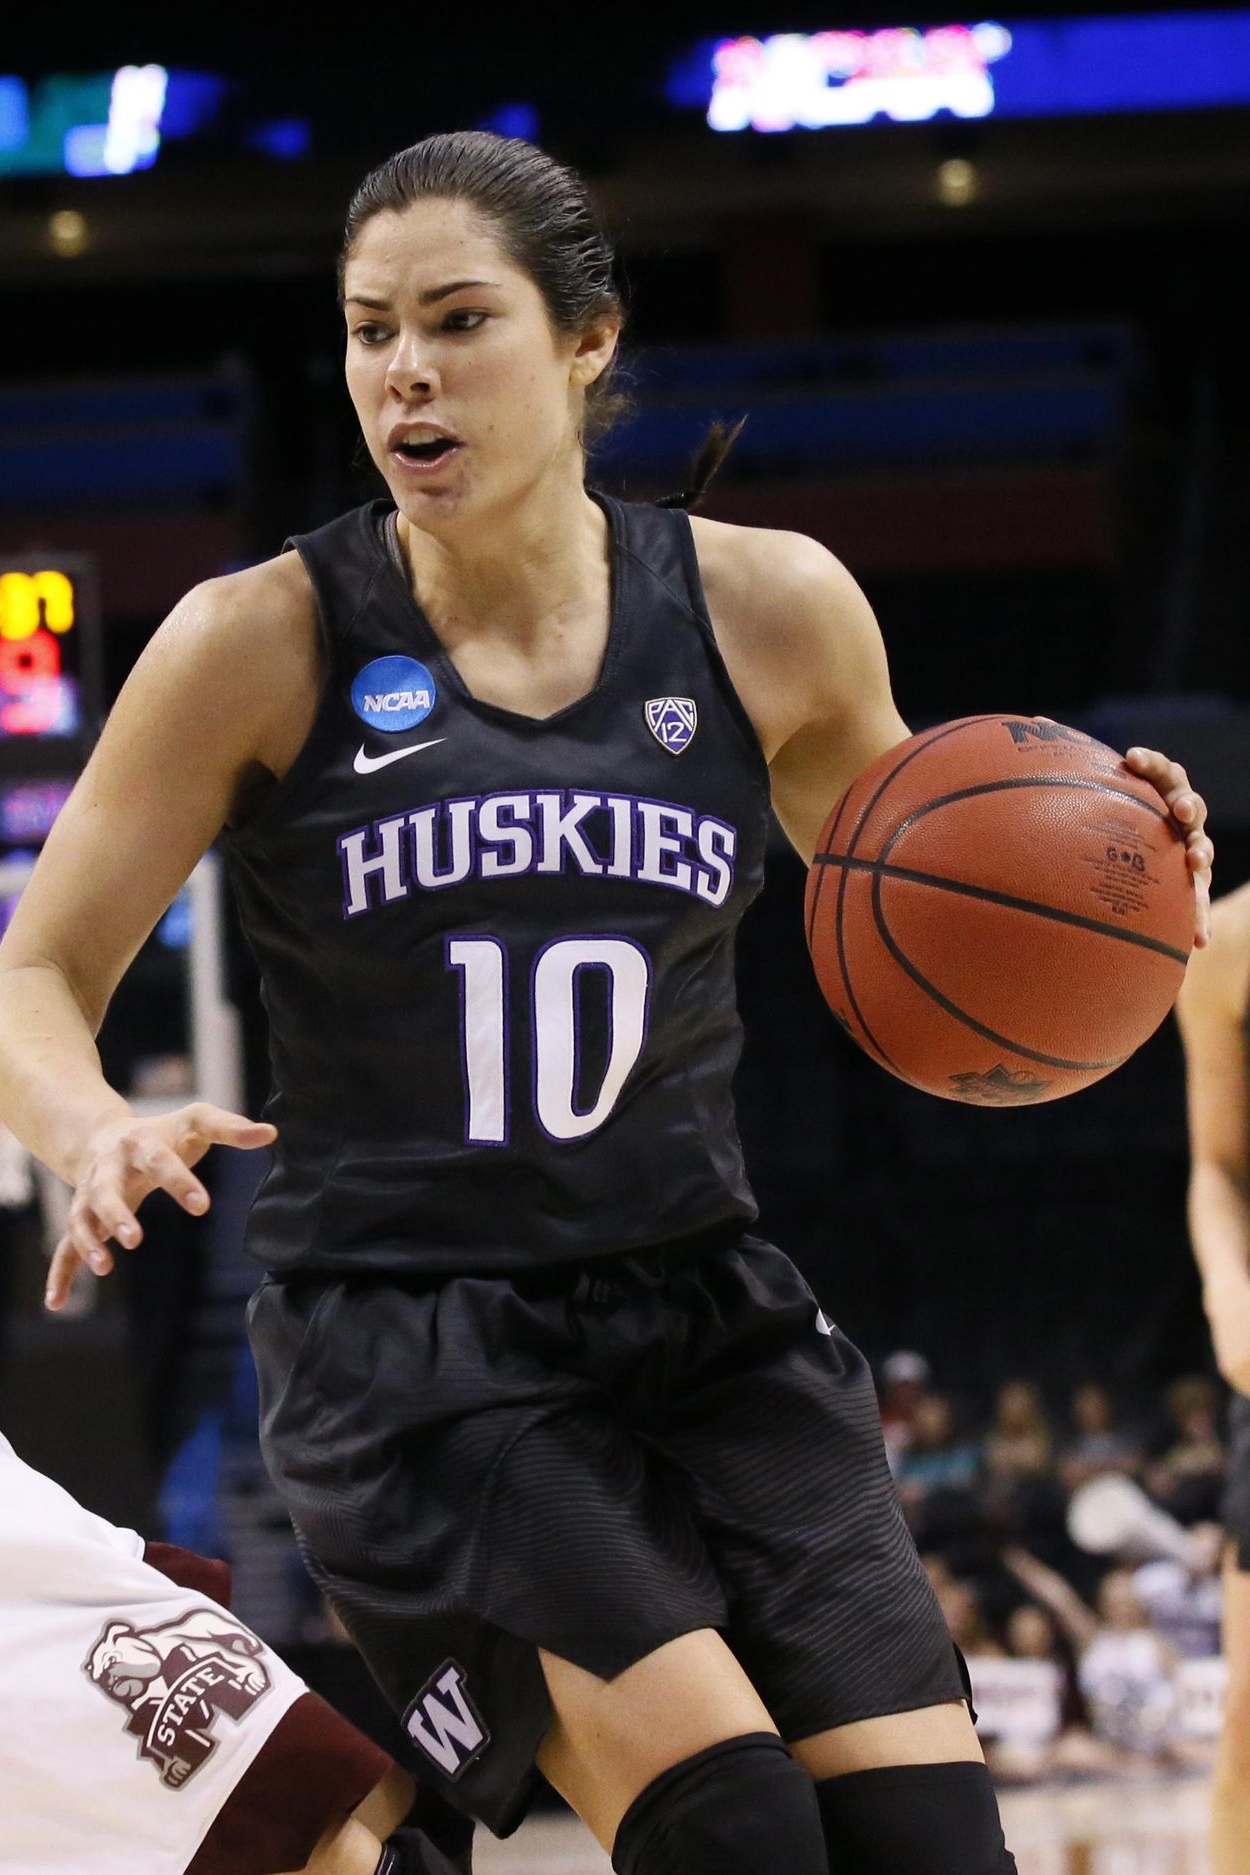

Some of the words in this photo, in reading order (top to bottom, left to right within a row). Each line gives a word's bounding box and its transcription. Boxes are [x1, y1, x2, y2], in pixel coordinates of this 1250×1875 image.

[363, 690, 431, 713] NCAA
[648, 699, 695, 733] PAC
[661, 721, 688, 743] 12
[337, 789, 738, 919] HUSKIES
[445, 934, 652, 1146] 10
[157, 1667, 225, 1746] STATE
[405, 1663, 486, 1777] W
